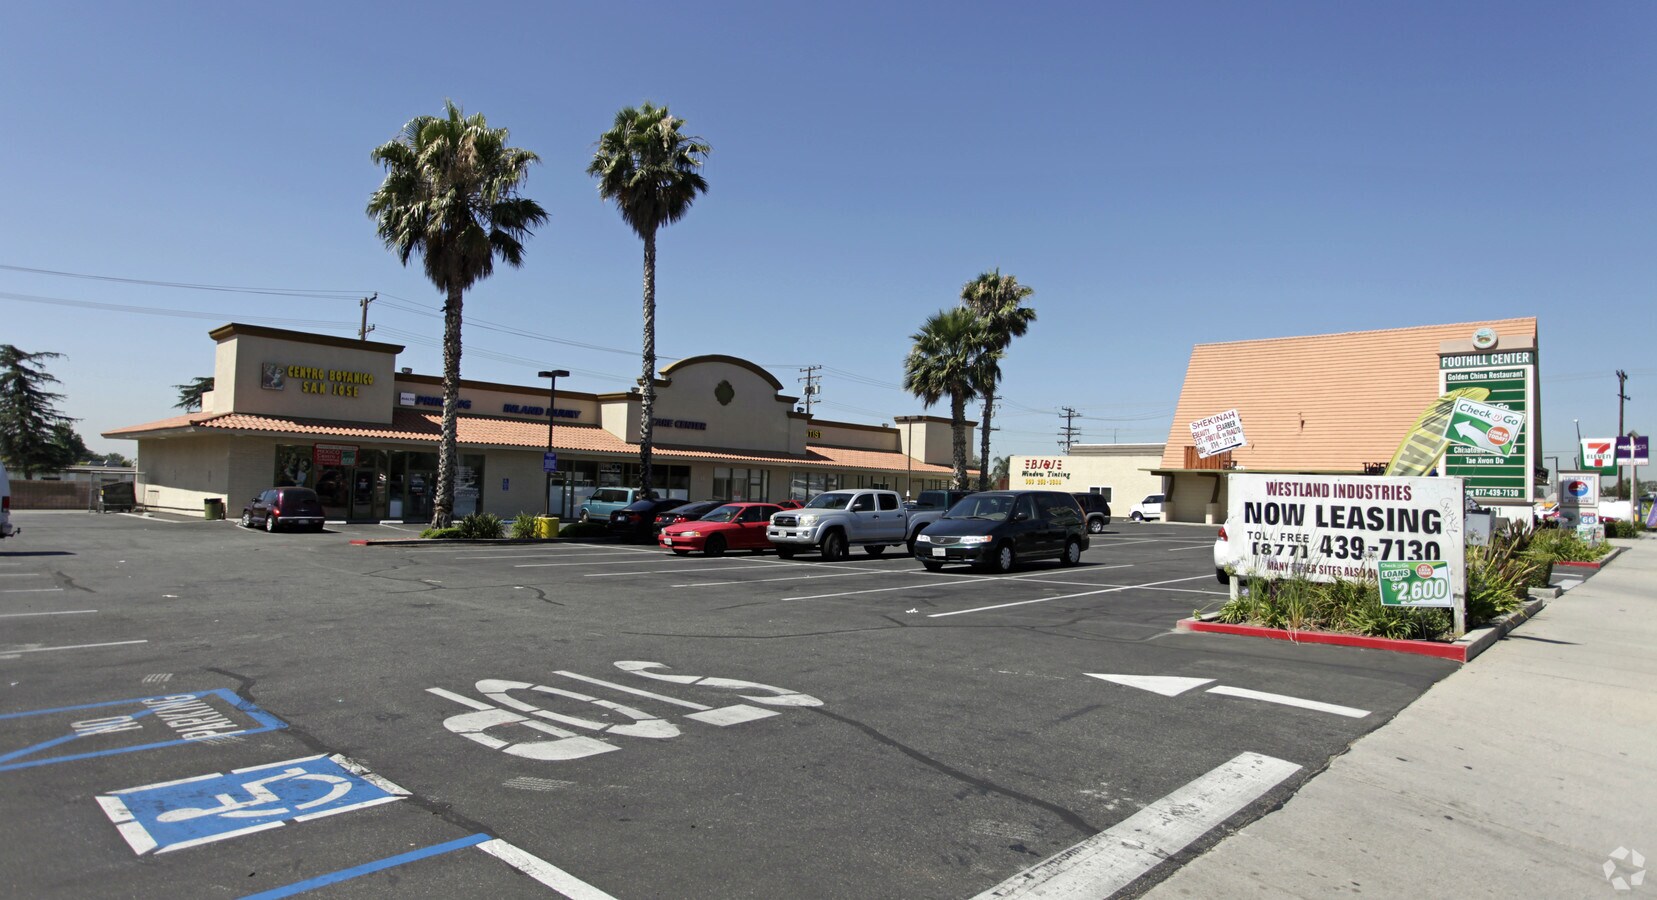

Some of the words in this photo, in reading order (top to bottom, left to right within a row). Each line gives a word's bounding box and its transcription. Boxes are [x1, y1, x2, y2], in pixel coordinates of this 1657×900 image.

[1442, 354, 1488, 367] FOOTHILL
[1491, 352, 1529, 365] CENTER
[287, 365, 324, 380] CENTRO
[329, 369, 374, 385] BOTANICO
[1447, 373, 1469, 381] Golden
[1489, 370, 1523, 379] Restaurant
[302, 381, 326, 395] SAN
[333, 383, 359, 397] JOSE
[1191, 411, 1236, 430] SHEKINAH
[1460, 403, 1492, 419] Check
[1503, 415, 1518, 426] Go
[674, 420, 707, 431] CENTER
[1047, 470, 1071, 480] Tinting
[1266, 481, 1330, 498] WESTLAND
[1333, 483, 1412, 501] INDUSTRIES
[1475, 488, 1519, 497] 877-439-7130
[1244, 501, 1306, 526] NOW
[1315, 504, 1441, 535] LEASING
[1280, 532, 1309, 543] FREE
[1320, 534, 1441, 561] 439-7130
[1318, 564, 1341, 576] SITES
[1382, 569, 1409, 578] LOANS
[141, 694, 246, 740] PARKING
[425, 660, 824, 761] STOP
[70, 715, 143, 737] NO
